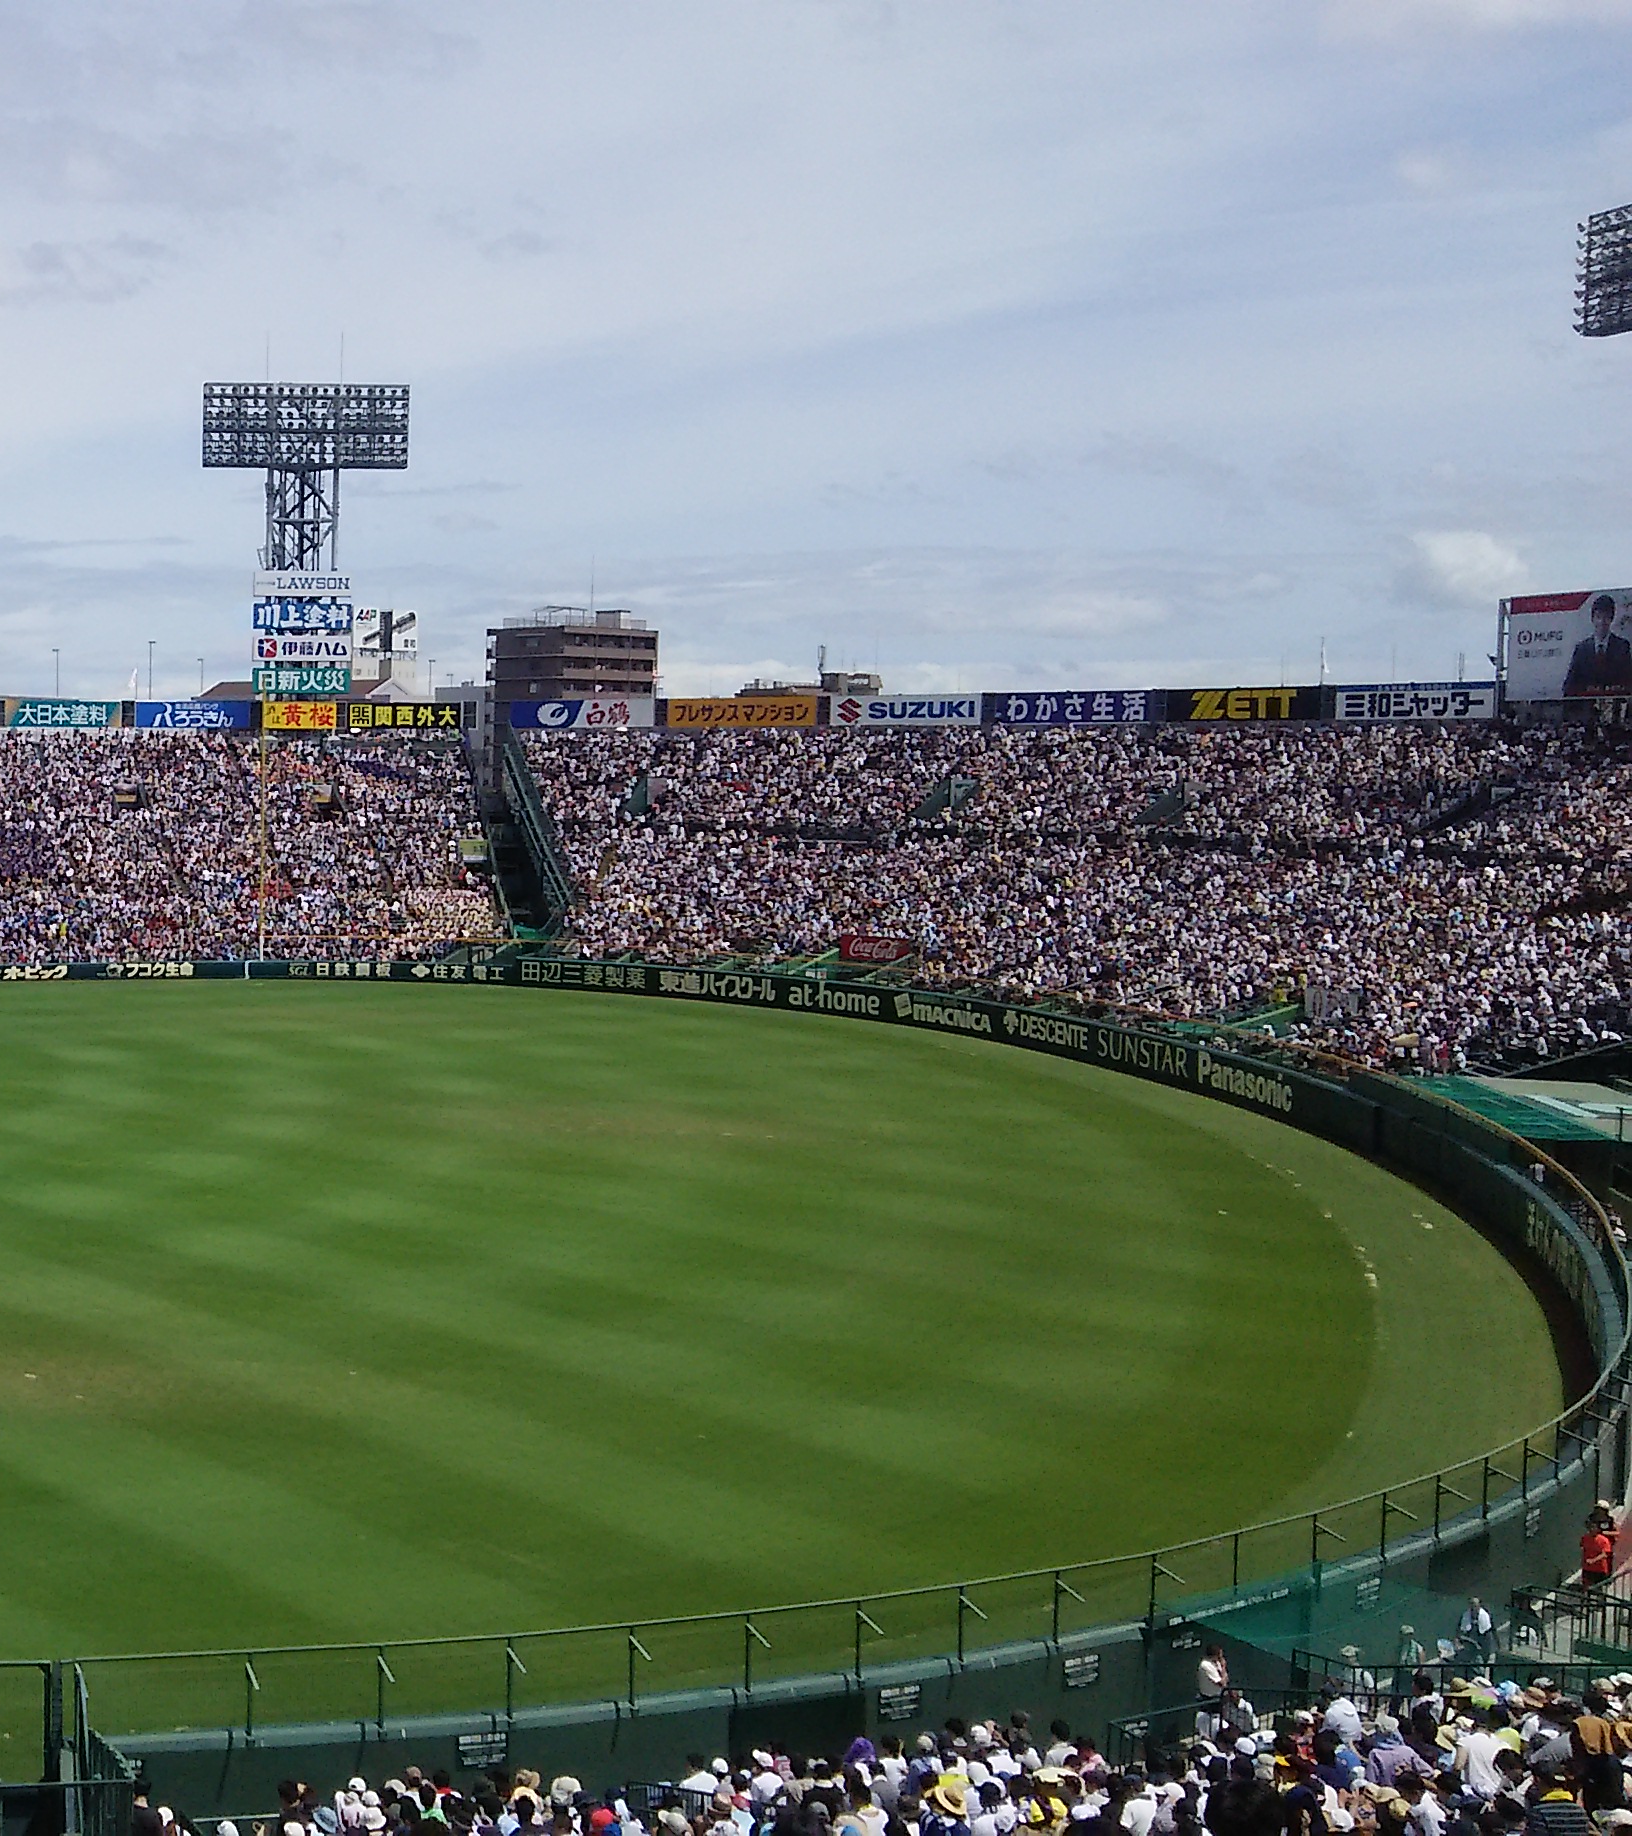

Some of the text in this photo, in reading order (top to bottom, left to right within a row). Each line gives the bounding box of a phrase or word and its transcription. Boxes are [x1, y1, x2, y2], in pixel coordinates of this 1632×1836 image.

[276, 577, 350, 590] LAWSON
[257, 604, 351, 628] 川上塗料
[1534, 630, 1564, 642] MUFG
[281, 641, 348, 657] 伊藤ハム
[256, 670, 346, 691] 日新火災
[18, 703, 107, 725] 大日本塗料
[585, 701, 630, 726] 白鶴
[868, 700, 976, 719] SUZUKI
[1007, 693, 1147, 722] わかさ生活
[1189, 689, 1298, 719] ZETT
[1344, 691, 1485, 718] 三和シャッター
[174, 711, 233, 727] ろうきん
[282, 704, 334, 727] 黄桜
[375, 706, 457, 726] 関西外大
[2, 965, 68, 980] オービック
[126, 962, 194, 978] フコク生命
[316, 962, 391, 978] 日鉄鋼板
[659, 970, 777, 1002] 東進ハイスクール
[1019, 1014, 1089, 1051] DESCENTE
[1097, 1028, 1190, 1078] SUNSTAR
[1197, 1050, 1294, 1113] Panasonic
